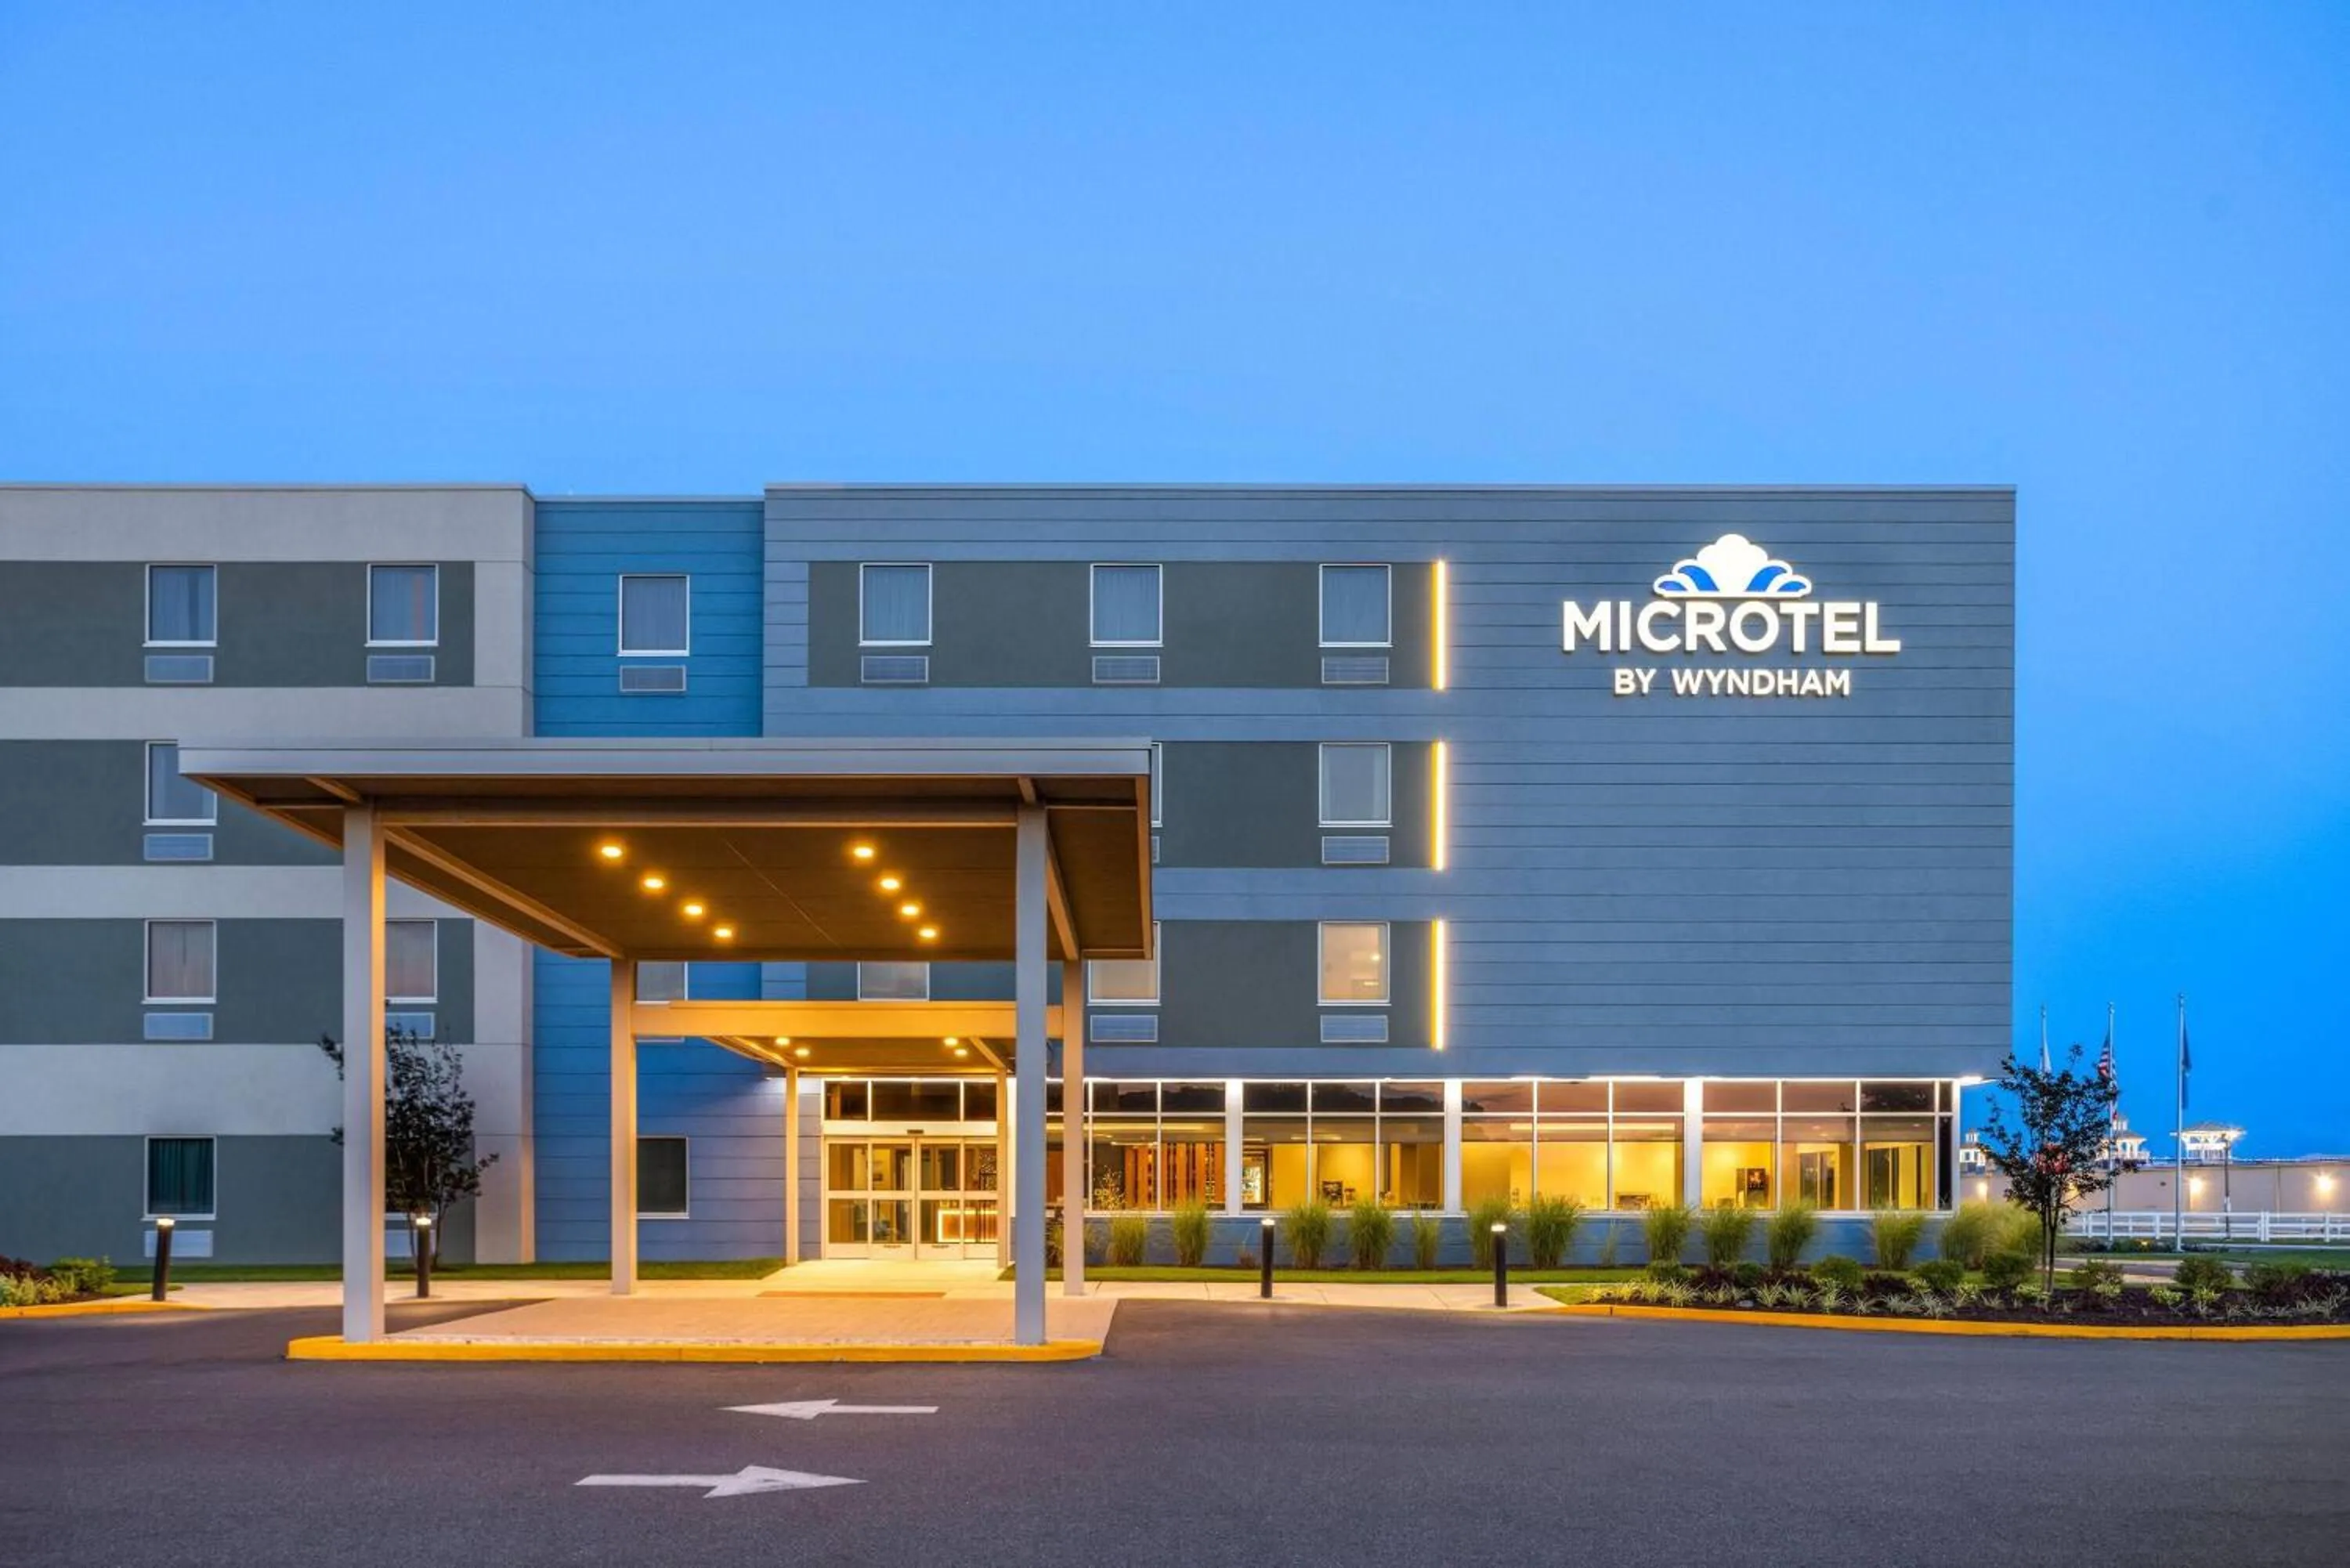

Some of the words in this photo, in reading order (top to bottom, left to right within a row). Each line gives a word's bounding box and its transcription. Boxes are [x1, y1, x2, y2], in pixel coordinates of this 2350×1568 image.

[1562, 600, 1902, 653] MICROTEL
[1613, 667, 1657, 695] BY
[1672, 668, 1850, 695] WYNDHAM
